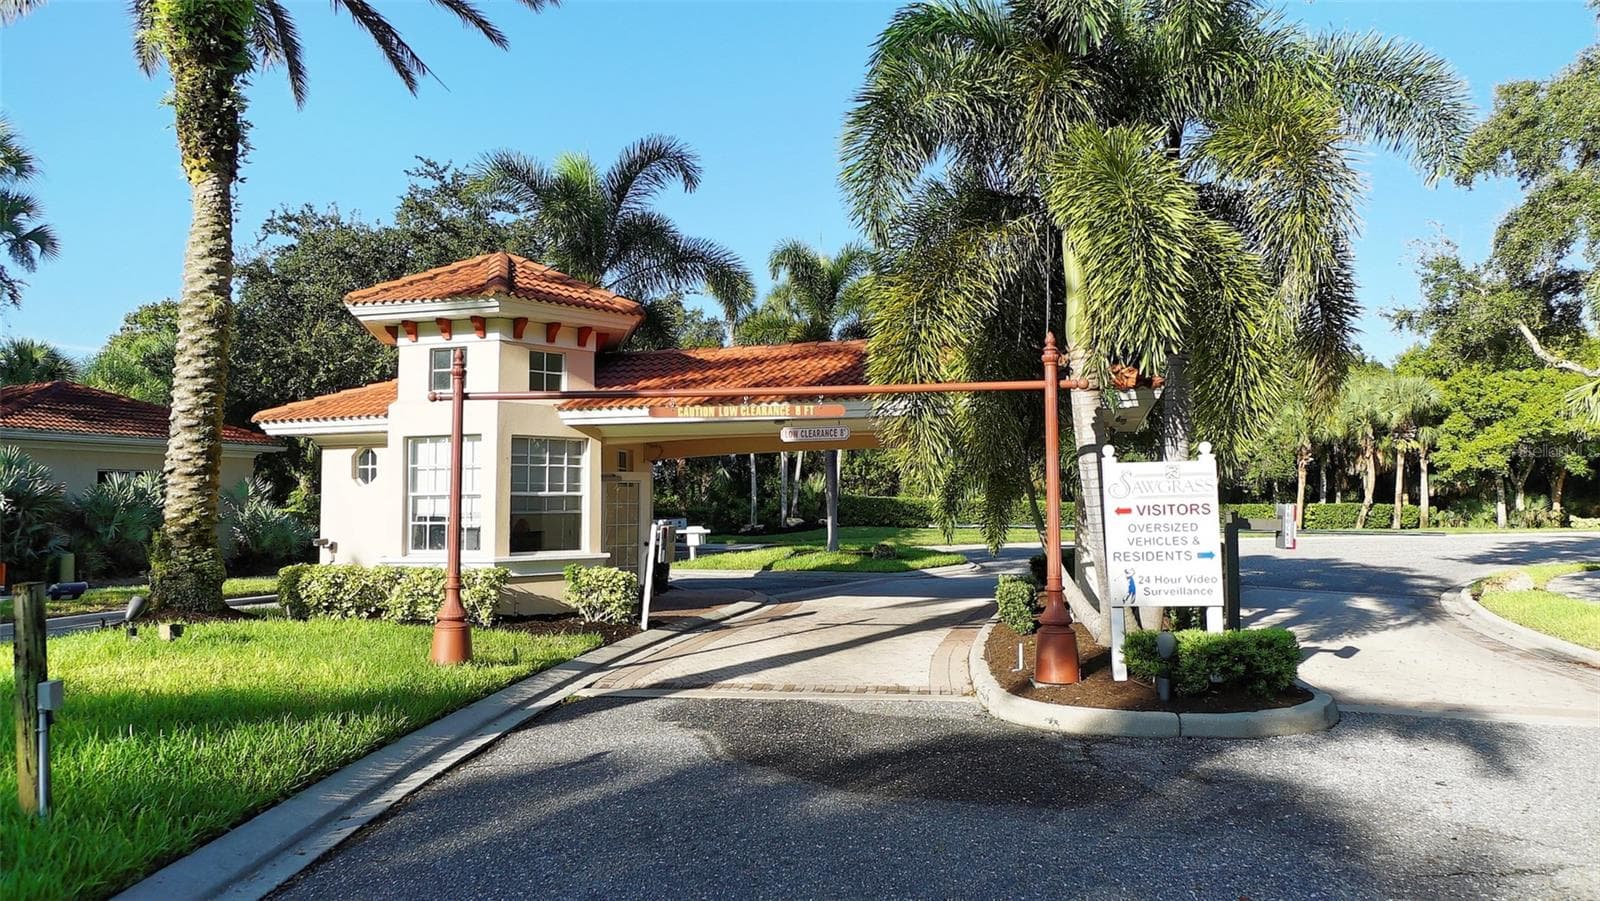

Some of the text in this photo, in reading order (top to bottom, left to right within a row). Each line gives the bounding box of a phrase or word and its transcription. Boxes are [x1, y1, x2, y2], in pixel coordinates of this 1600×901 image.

[677, 405, 715, 418] CAUTION
[718, 405, 738, 417] LOW
[740, 405, 791, 417] CLEARANCE
[803, 404, 815, 416] FT
[784, 430, 799, 439] LOW
[800, 428, 838, 438] CLEARANCE
[1136, 503, 1211, 516] VISITORS
[1128, 522, 1198, 533] OVERSIZED
[1127, 536, 1200, 546] VEHICLES &
[1113, 550, 1193, 562] RESIDENTS
[1138, 574, 1218, 584] 24 Hour Video
[1143, 586, 1214, 597] Surveillance
